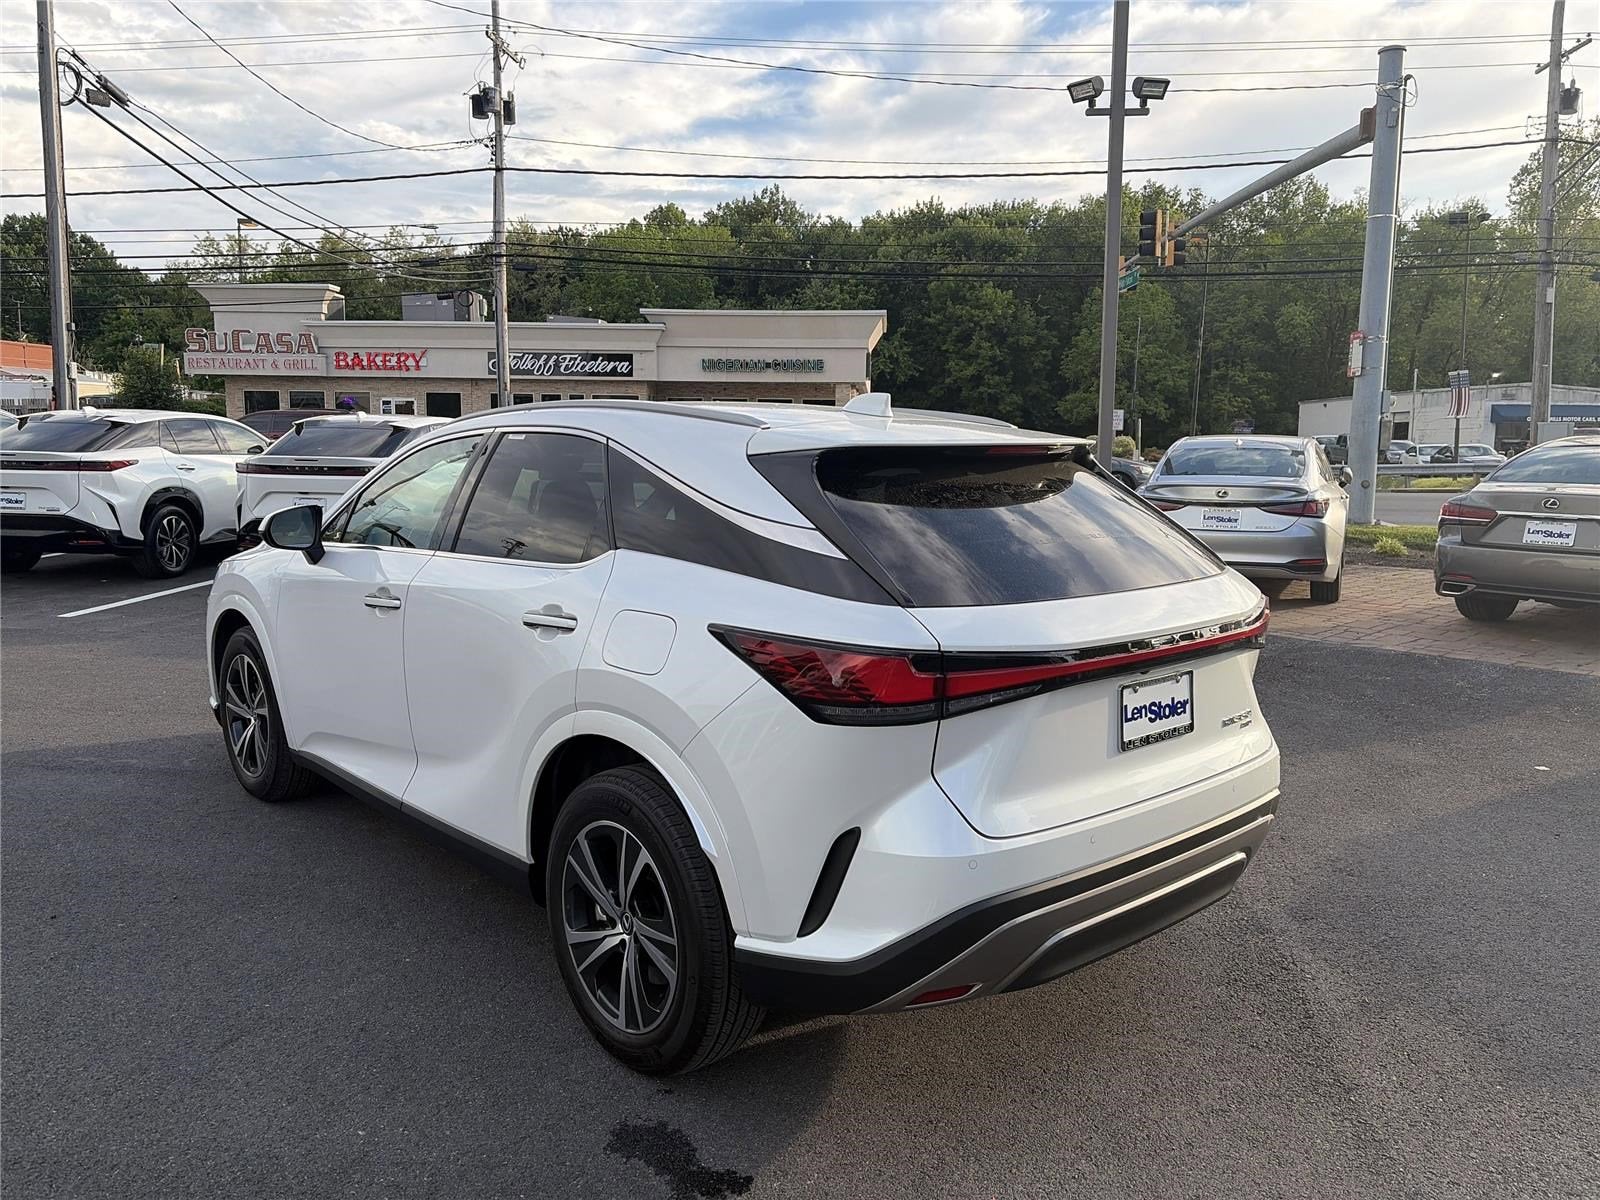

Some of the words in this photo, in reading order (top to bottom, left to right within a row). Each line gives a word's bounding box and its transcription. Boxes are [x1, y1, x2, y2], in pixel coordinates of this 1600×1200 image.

[187, 357, 267, 370] RESTAURANT
[271, 357, 280, 370] &
[283, 358, 319, 371] GRILL
[333, 349, 428, 372] BAKERY
[559, 353, 633, 374] Etcetera
[701, 358, 766, 373] NIGERIAN
[771, 359, 825, 373] CUISINE
[1203, 514, 1239, 524] LenStoler
[1527, 527, 1572, 539] LenStoler
[1123, 696, 1189, 723] LenStoler
[1126, 737, 1147, 751] LEN
[1149, 724, 1192, 743] STOLER
